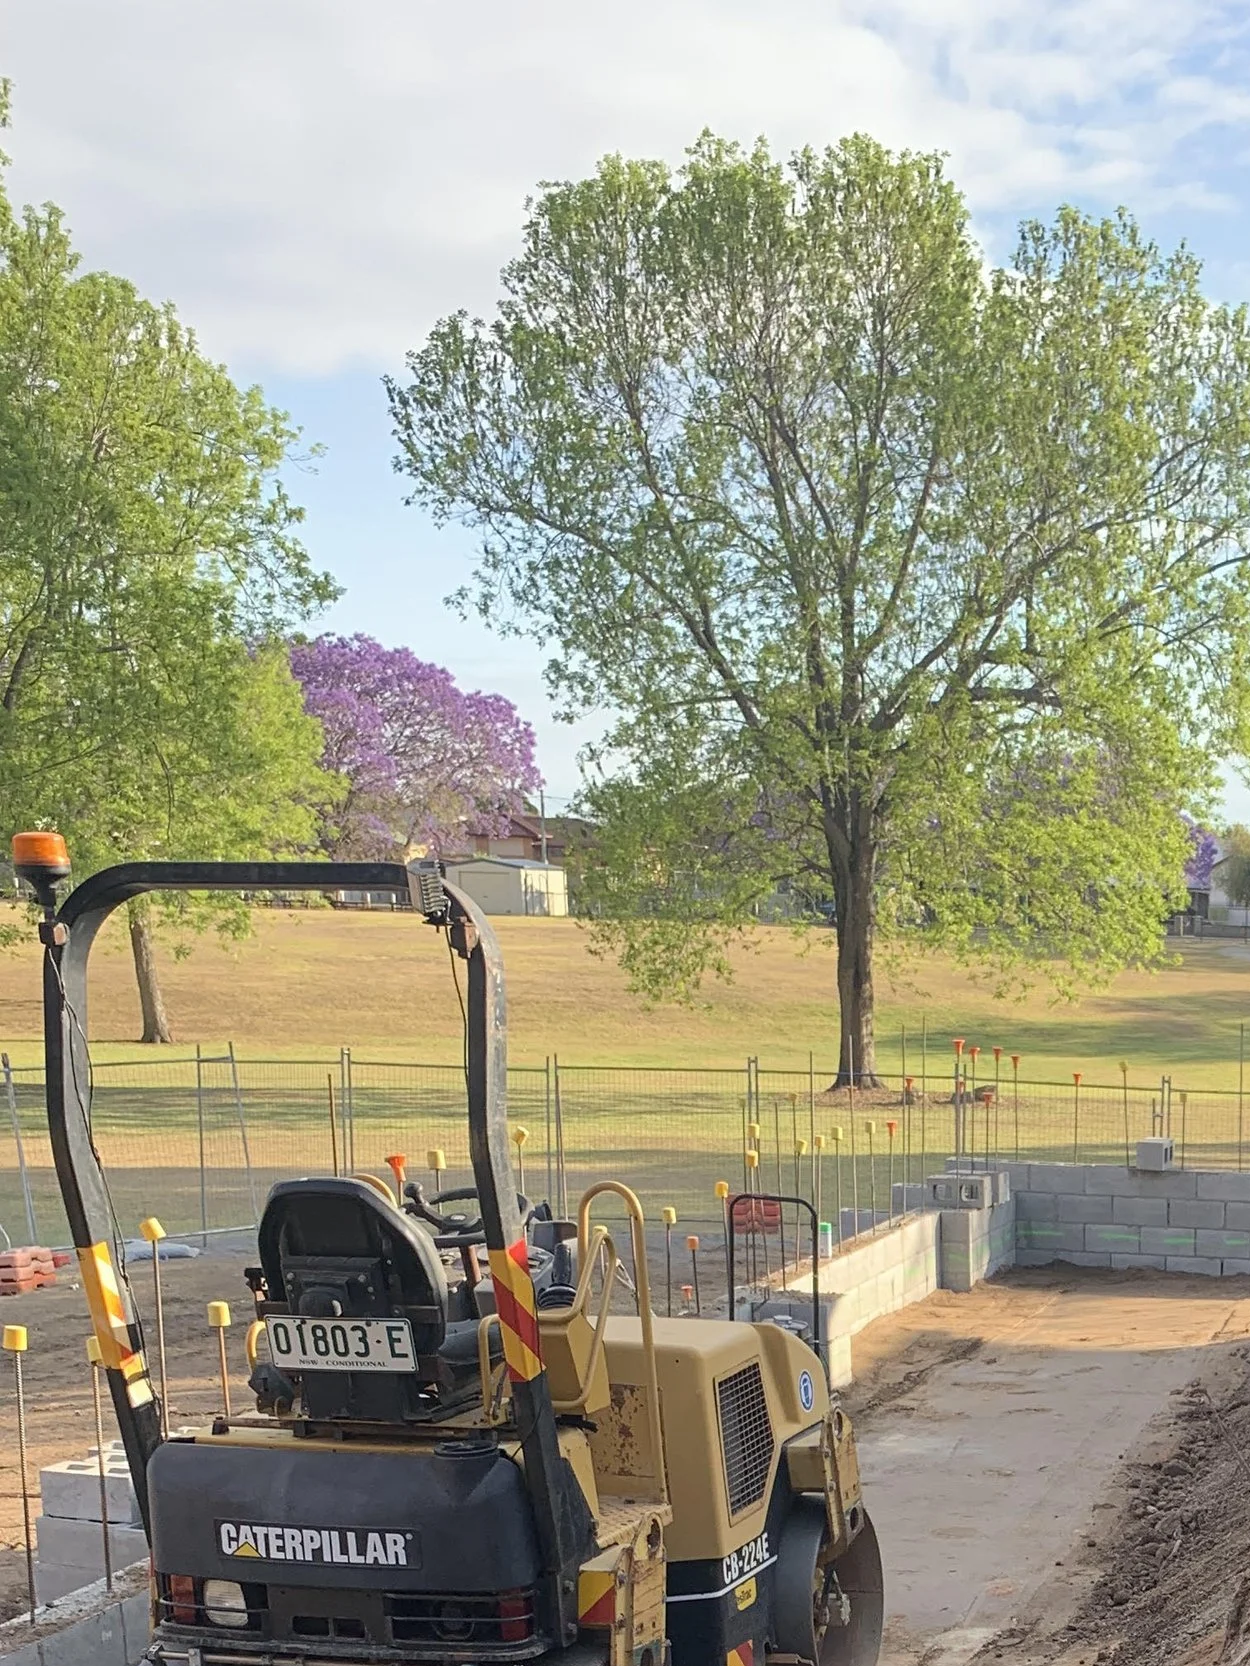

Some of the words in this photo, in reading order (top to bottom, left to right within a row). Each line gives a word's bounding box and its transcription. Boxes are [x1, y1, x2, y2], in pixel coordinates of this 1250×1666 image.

[325, 1359, 388, 1368] CONDITIONAL
[220, 1522, 408, 1566] CATERPILLAR
[722, 1532, 770, 1585] CB-224E
